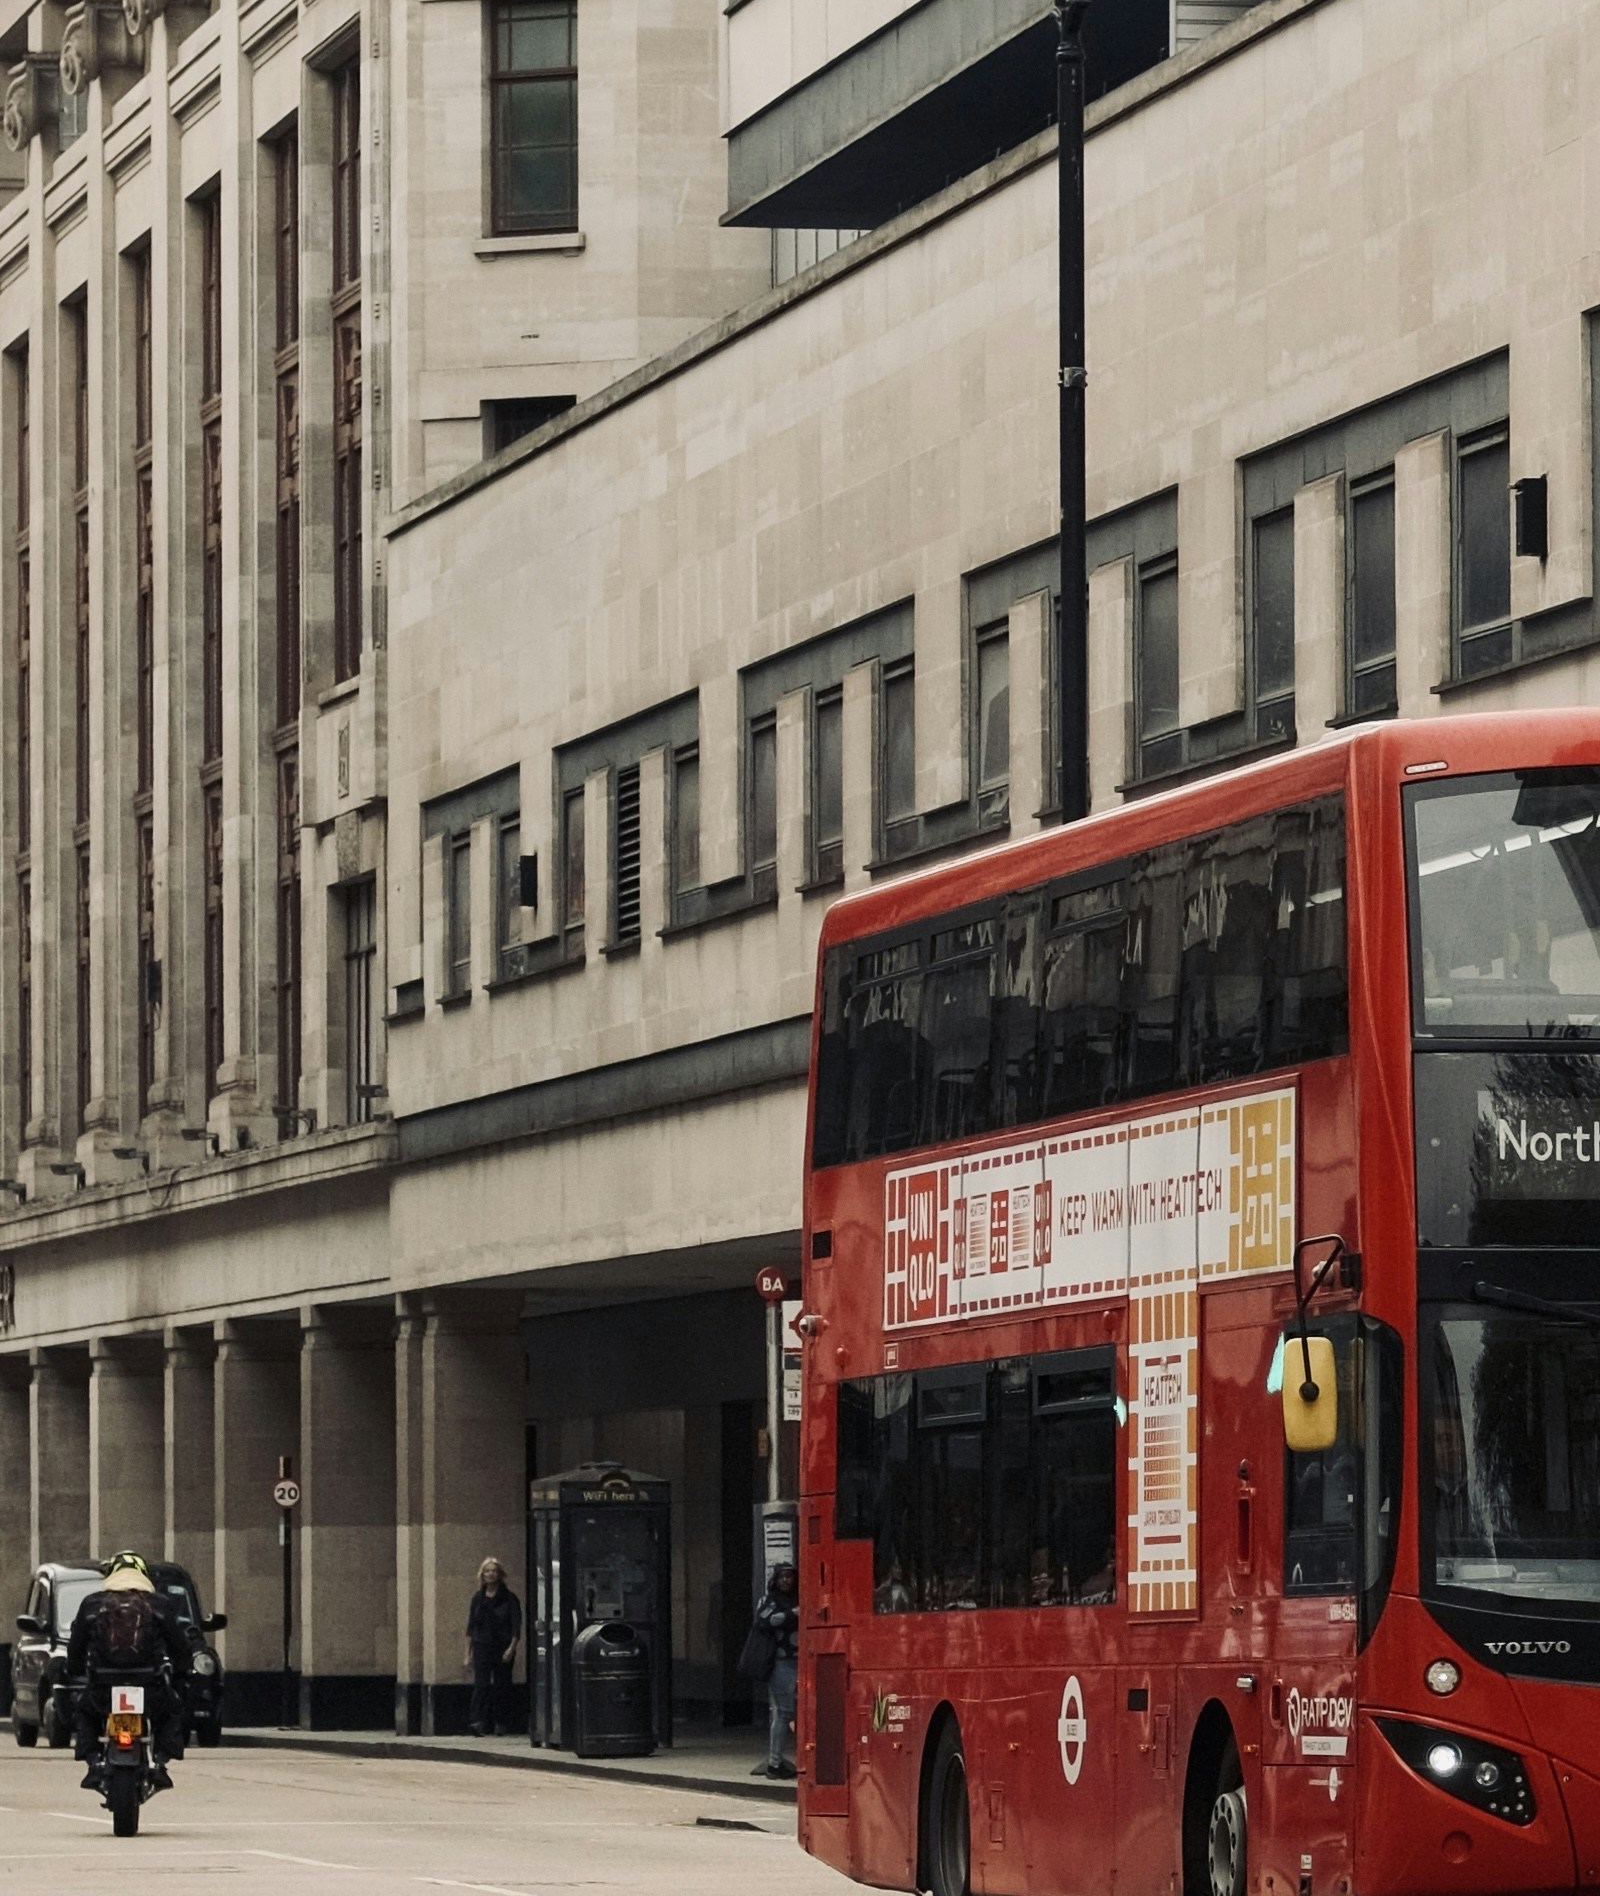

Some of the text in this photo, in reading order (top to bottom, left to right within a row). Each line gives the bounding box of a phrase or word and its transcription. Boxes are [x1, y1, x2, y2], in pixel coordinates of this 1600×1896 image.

[1059, 1168, 1223, 1237] KEEP WARM WITH HEATTECH
[909, 1190, 934, 1242] UNI
[761, 1277, 785, 1292] BA
[909, 1251, 935, 1312] QLO
[1144, 1373, 1182, 1408] HEATTECH
[276, 1487, 298, 1500] 20
[1483, 1641, 1571, 1655] VOLVO
[119, 1693, 135, 1711] L
